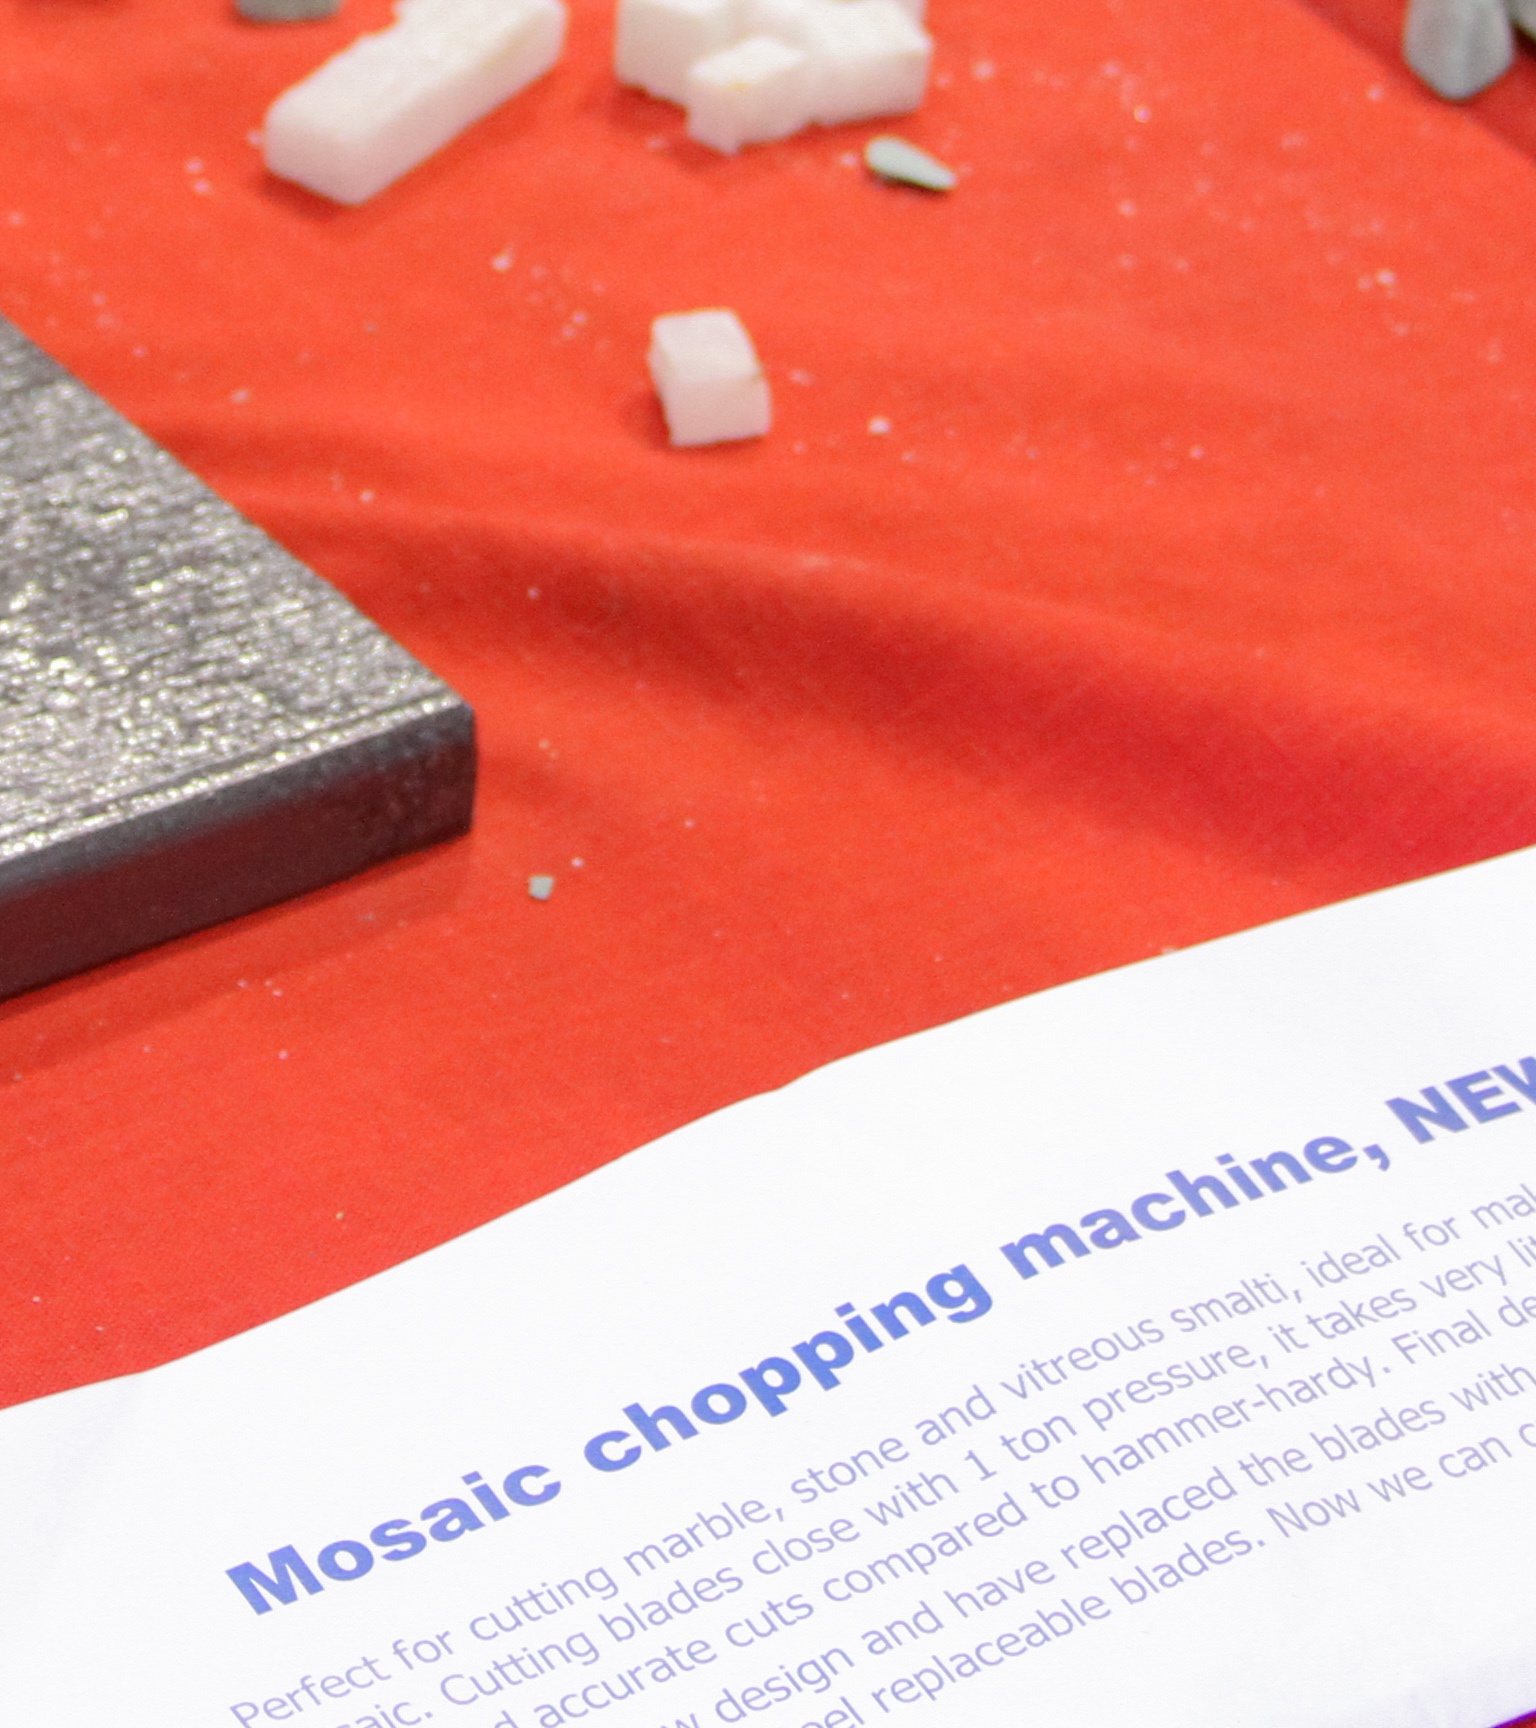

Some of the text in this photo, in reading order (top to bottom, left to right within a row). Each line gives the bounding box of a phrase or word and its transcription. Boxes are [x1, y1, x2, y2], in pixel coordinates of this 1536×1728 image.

[226, 1465, 561, 1614] Mosaic
[584, 1264, 992, 1472] chopping
[1000, 1137, 1390, 1279] machine,
[230, 1657, 390, 1728] Perfect
[393, 1631, 452, 1669] for
[470, 1567, 618, 1640] cutting
[624, 1501, 783, 1576] marble,
[791, 1438, 909, 1503] stone
[916, 1385, 996, 1445] and
[1001, 1319, 1164, 1399] vitreous
[1171, 1273, 1301, 1332] smalti,
[1300, 1235, 1400, 1287] ideal
[1403, 1218, 1459, 1250] for
[440, 1633, 599, 1705] Cutting
[599, 1568, 743, 1642] blades
[753, 1519, 860, 1574] close
[865, 1473, 958, 1525] with
[966, 1451, 996, 1480] 1
[1001, 1416, 1076, 1461] ton
[1083, 1346, 1268, 1431] pressure,
[1268, 1325, 1308, 1352] it
[1307, 1289, 1417, 1339] takes
[1422, 1256, 1506, 1297] very
[534, 1640, 717, 1728] accurate
[725, 1594, 814, 1647] cuts
[823, 1492, 1027, 1601] compared
[1030, 1476, 1080, 1508] to
[1081, 1357, 1389, 1483] hammer-hardy.
[1392, 1310, 1490, 1363] Final
[715, 1648, 854, 1723] design
[862, 1601, 943, 1655] and
[945, 1561, 1055, 1617] have
[1061, 1467, 1237, 1568] replaced
[1239, 1449, 1312, 1486] the
[1311, 1401, 1446, 1461] blades
[872, 1596, 1111, 1712] replaceable
[1110, 1531, 1264, 1604] blades.
[1267, 1490, 1360, 1537] Now
[1368, 1467, 1432, 1501] we
[1439, 1438, 1511, 1477] can
